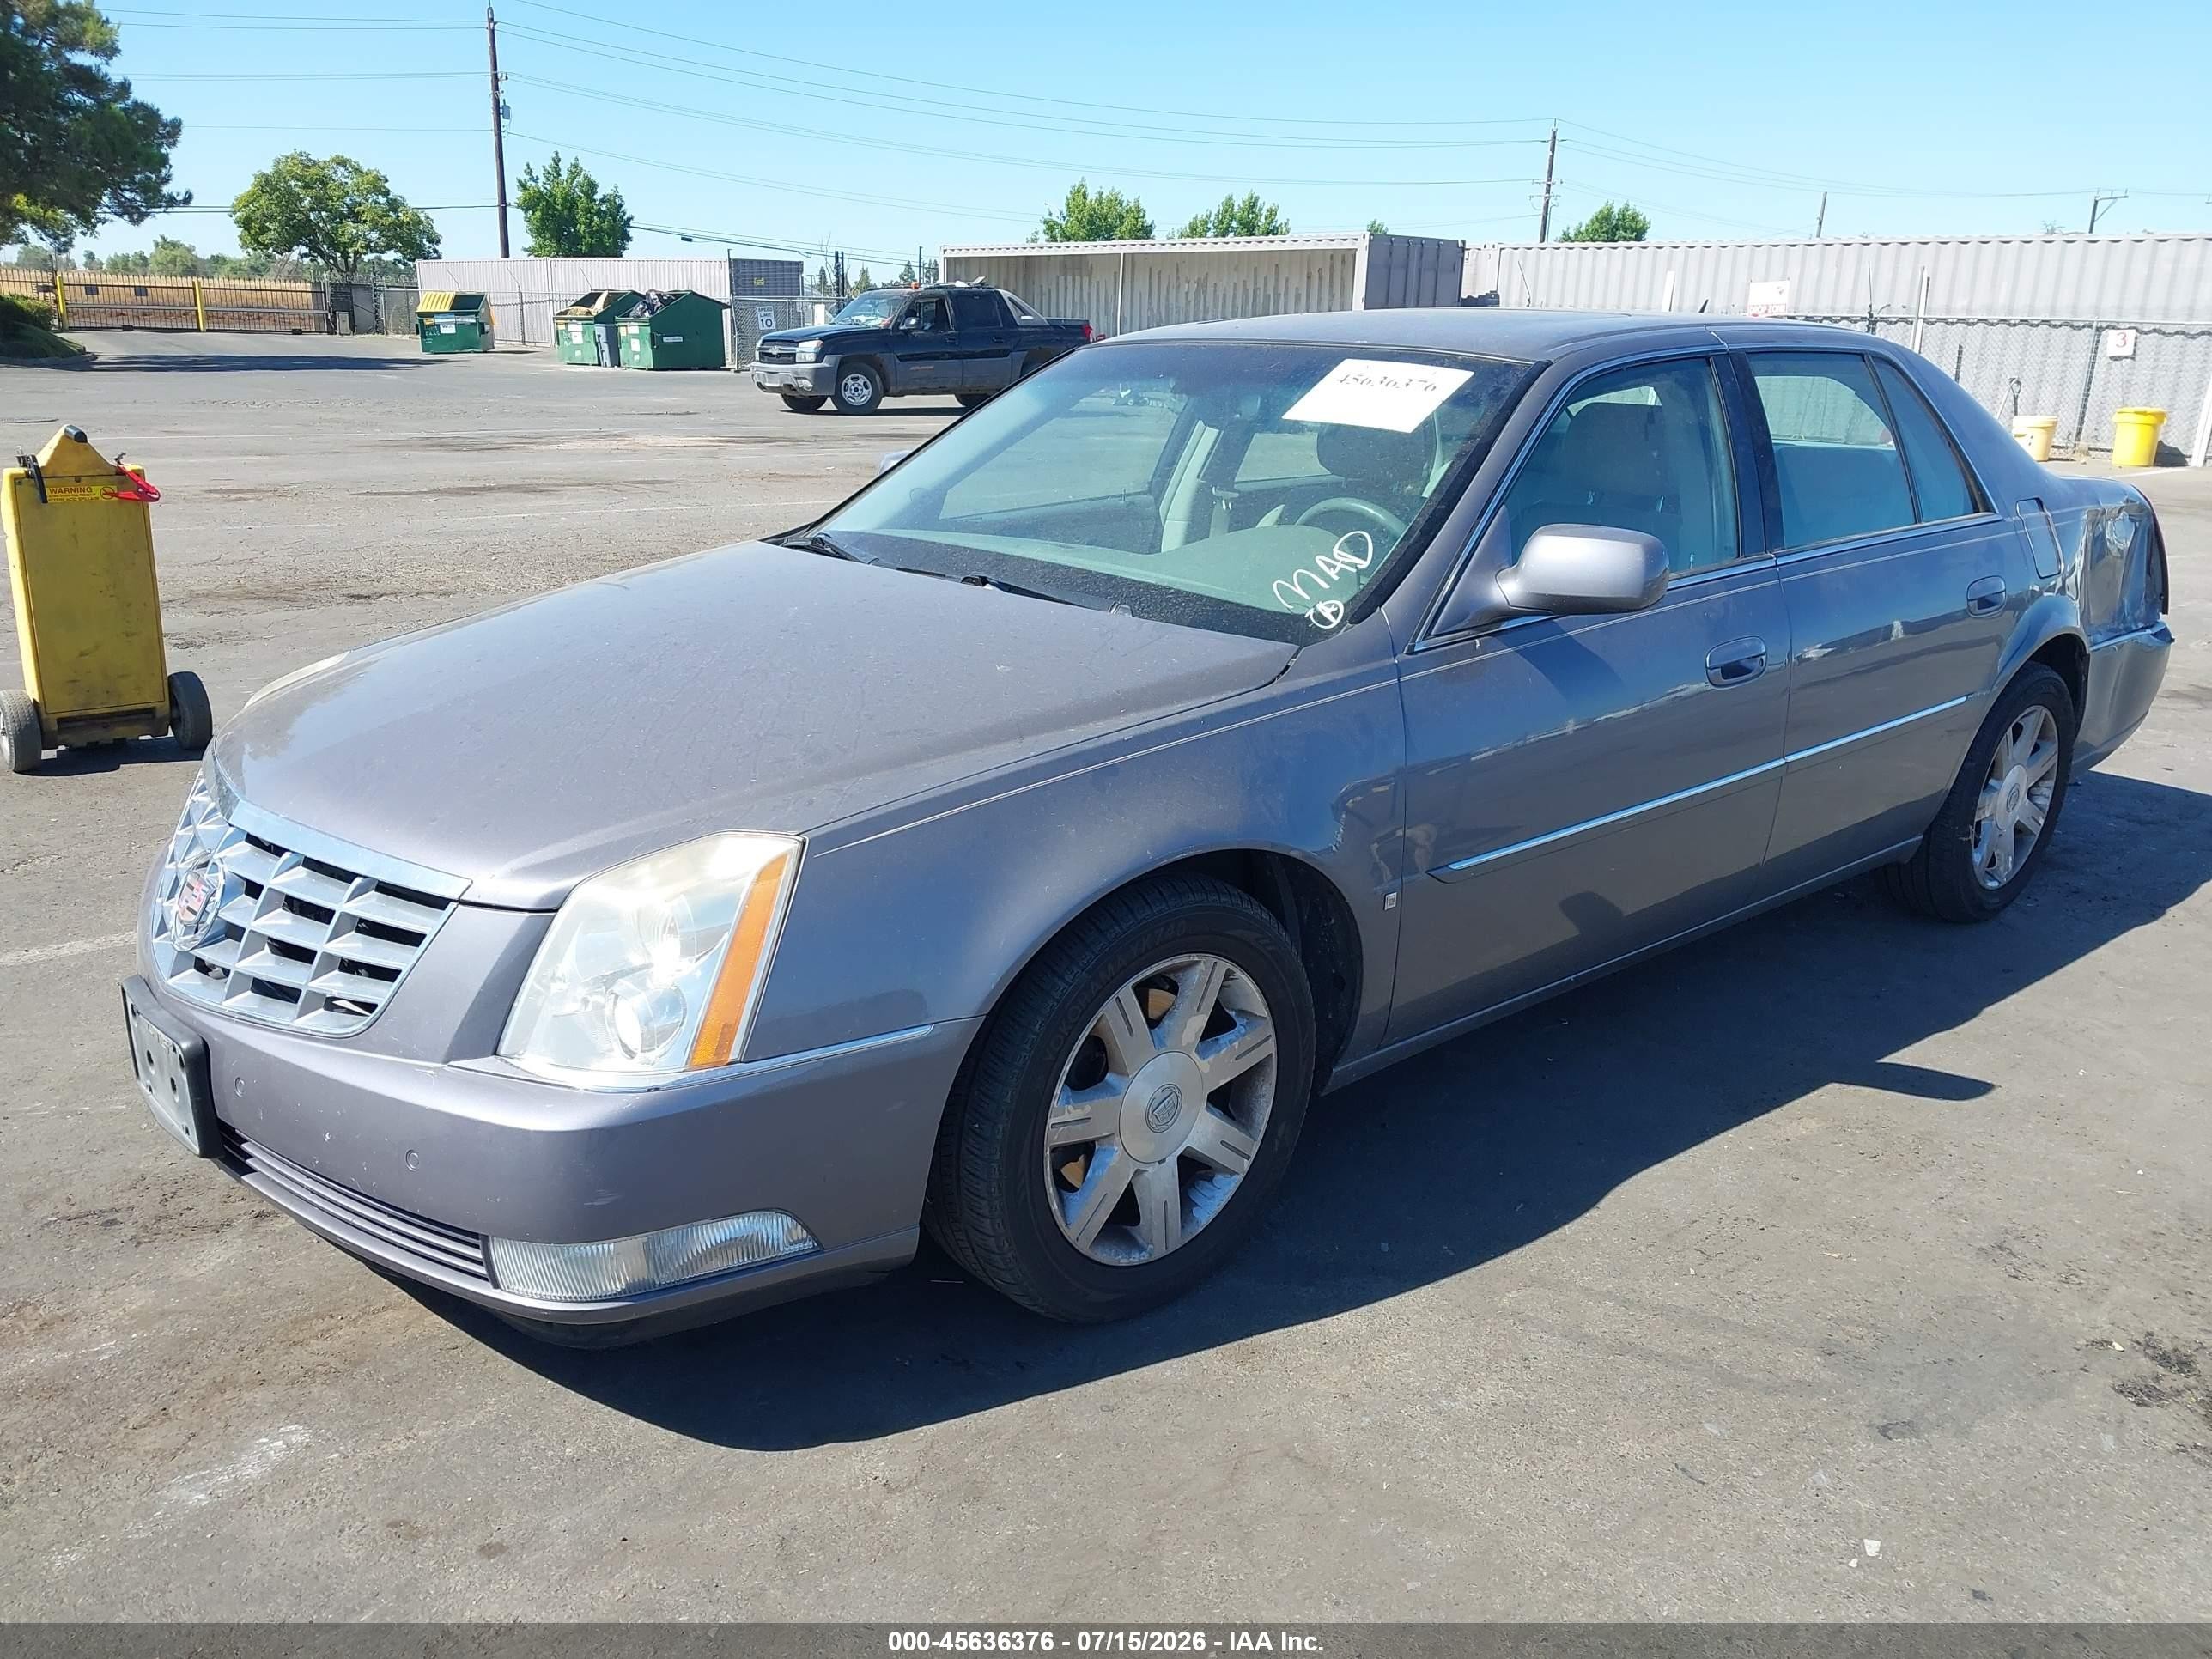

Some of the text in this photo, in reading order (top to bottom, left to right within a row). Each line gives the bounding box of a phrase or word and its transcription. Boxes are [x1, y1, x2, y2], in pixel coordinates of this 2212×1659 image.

[761, 318, 773, 328] 10
[2116, 331, 2128, 348] 3
[49, 486, 93, 495] WARNING
[1273, 530, 1374, 609] MAD
